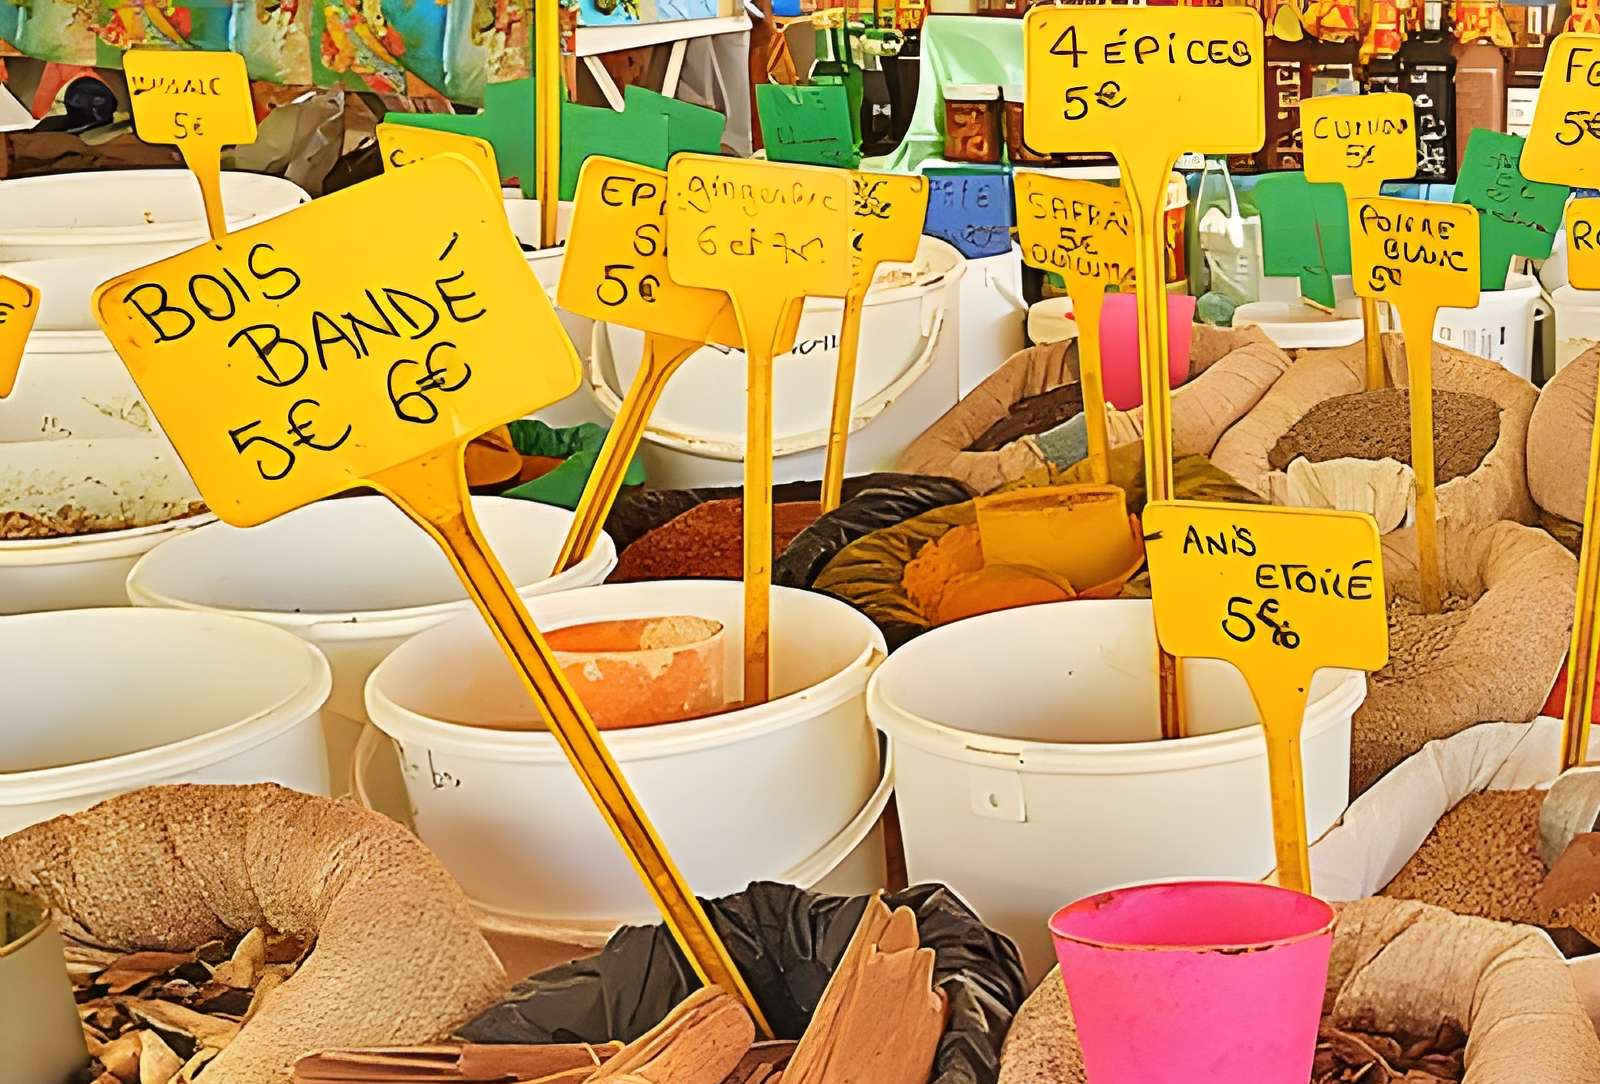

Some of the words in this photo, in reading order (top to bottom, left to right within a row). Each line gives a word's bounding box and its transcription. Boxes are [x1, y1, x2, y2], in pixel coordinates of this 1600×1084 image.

[1050, 25, 1088, 68] 4
[1104, 28, 1252, 67] ÉPICES
[1064, 80, 1128, 121] 5€
[124, 243, 301, 344] BOIS
[227, 231, 487, 387] BANDÉ
[227, 398, 352, 480] 5€
[387, 341, 472, 424] 6€
[1182, 524, 1257, 557] ANIS
